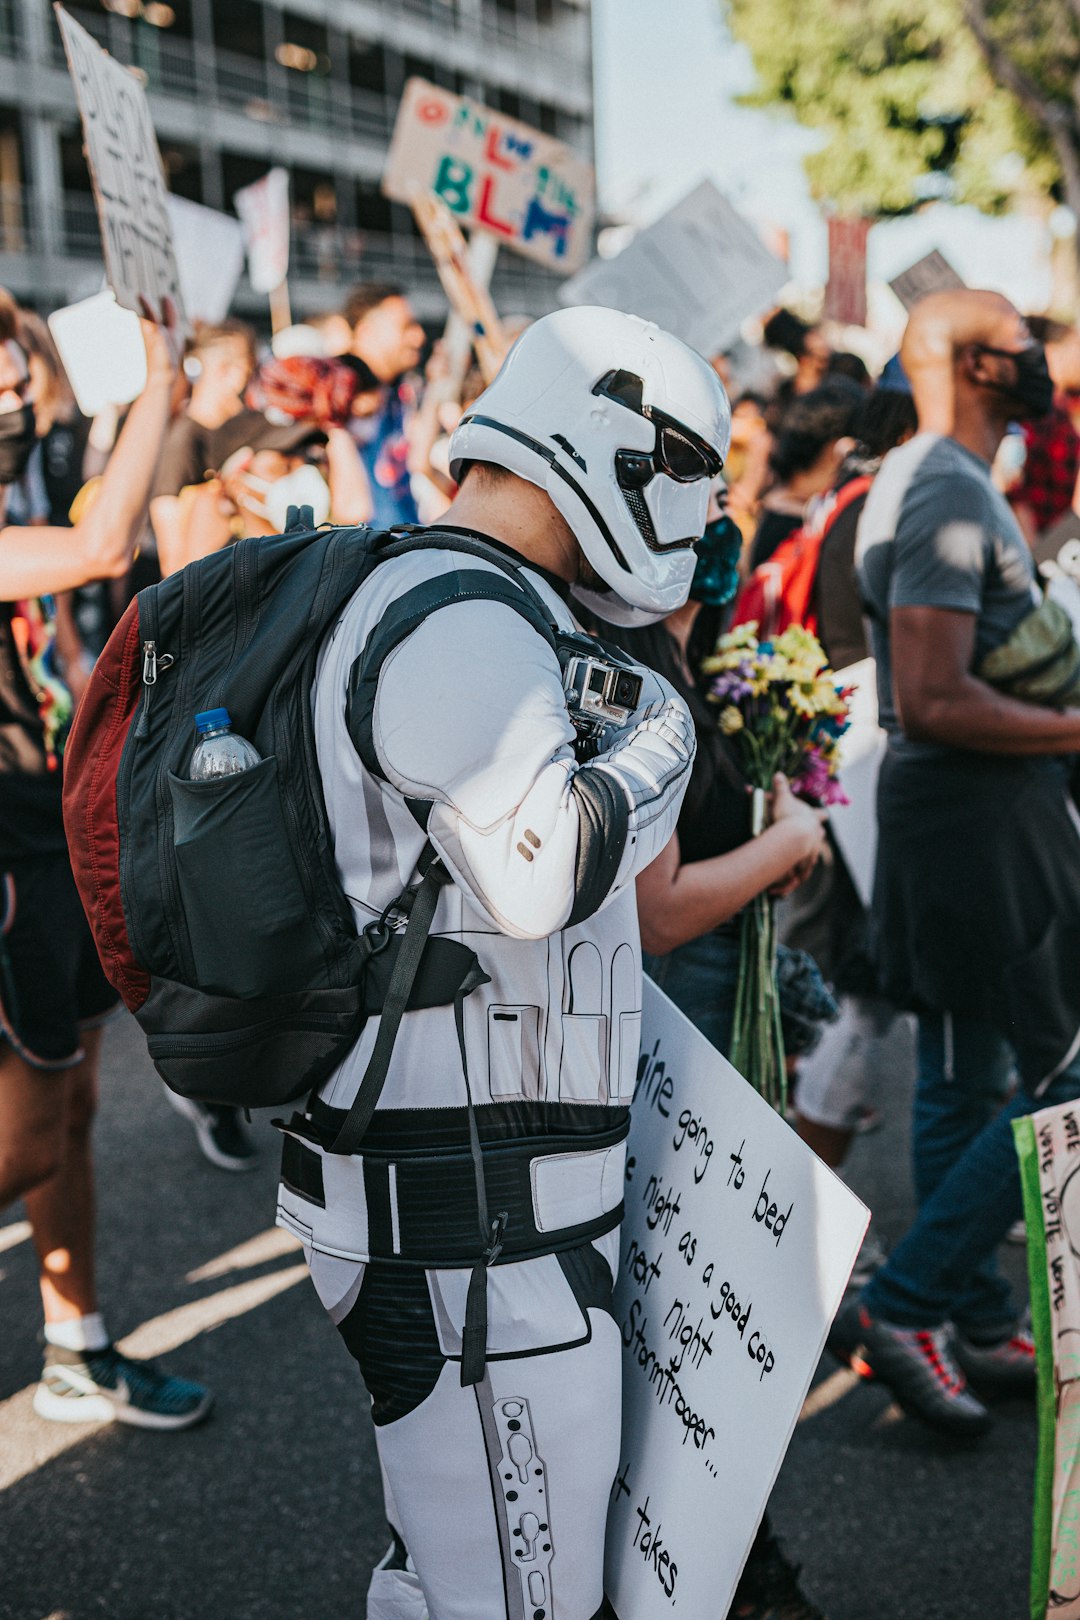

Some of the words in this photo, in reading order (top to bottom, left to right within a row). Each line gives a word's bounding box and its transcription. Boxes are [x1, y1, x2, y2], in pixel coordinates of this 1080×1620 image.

[434, 155, 571, 258] BLM
[672, 1109, 713, 1184] going
[727, 1139, 746, 1190] to
[751, 1168, 794, 1247] bed
[1043, 1187, 1062, 1243] VOTE
[643, 1174, 682, 1237] night
[678, 1231, 697, 1266] as
[702, 1262, 715, 1288] a
[710, 1281, 752, 1340] good
[662, 1298, 713, 1374] night
